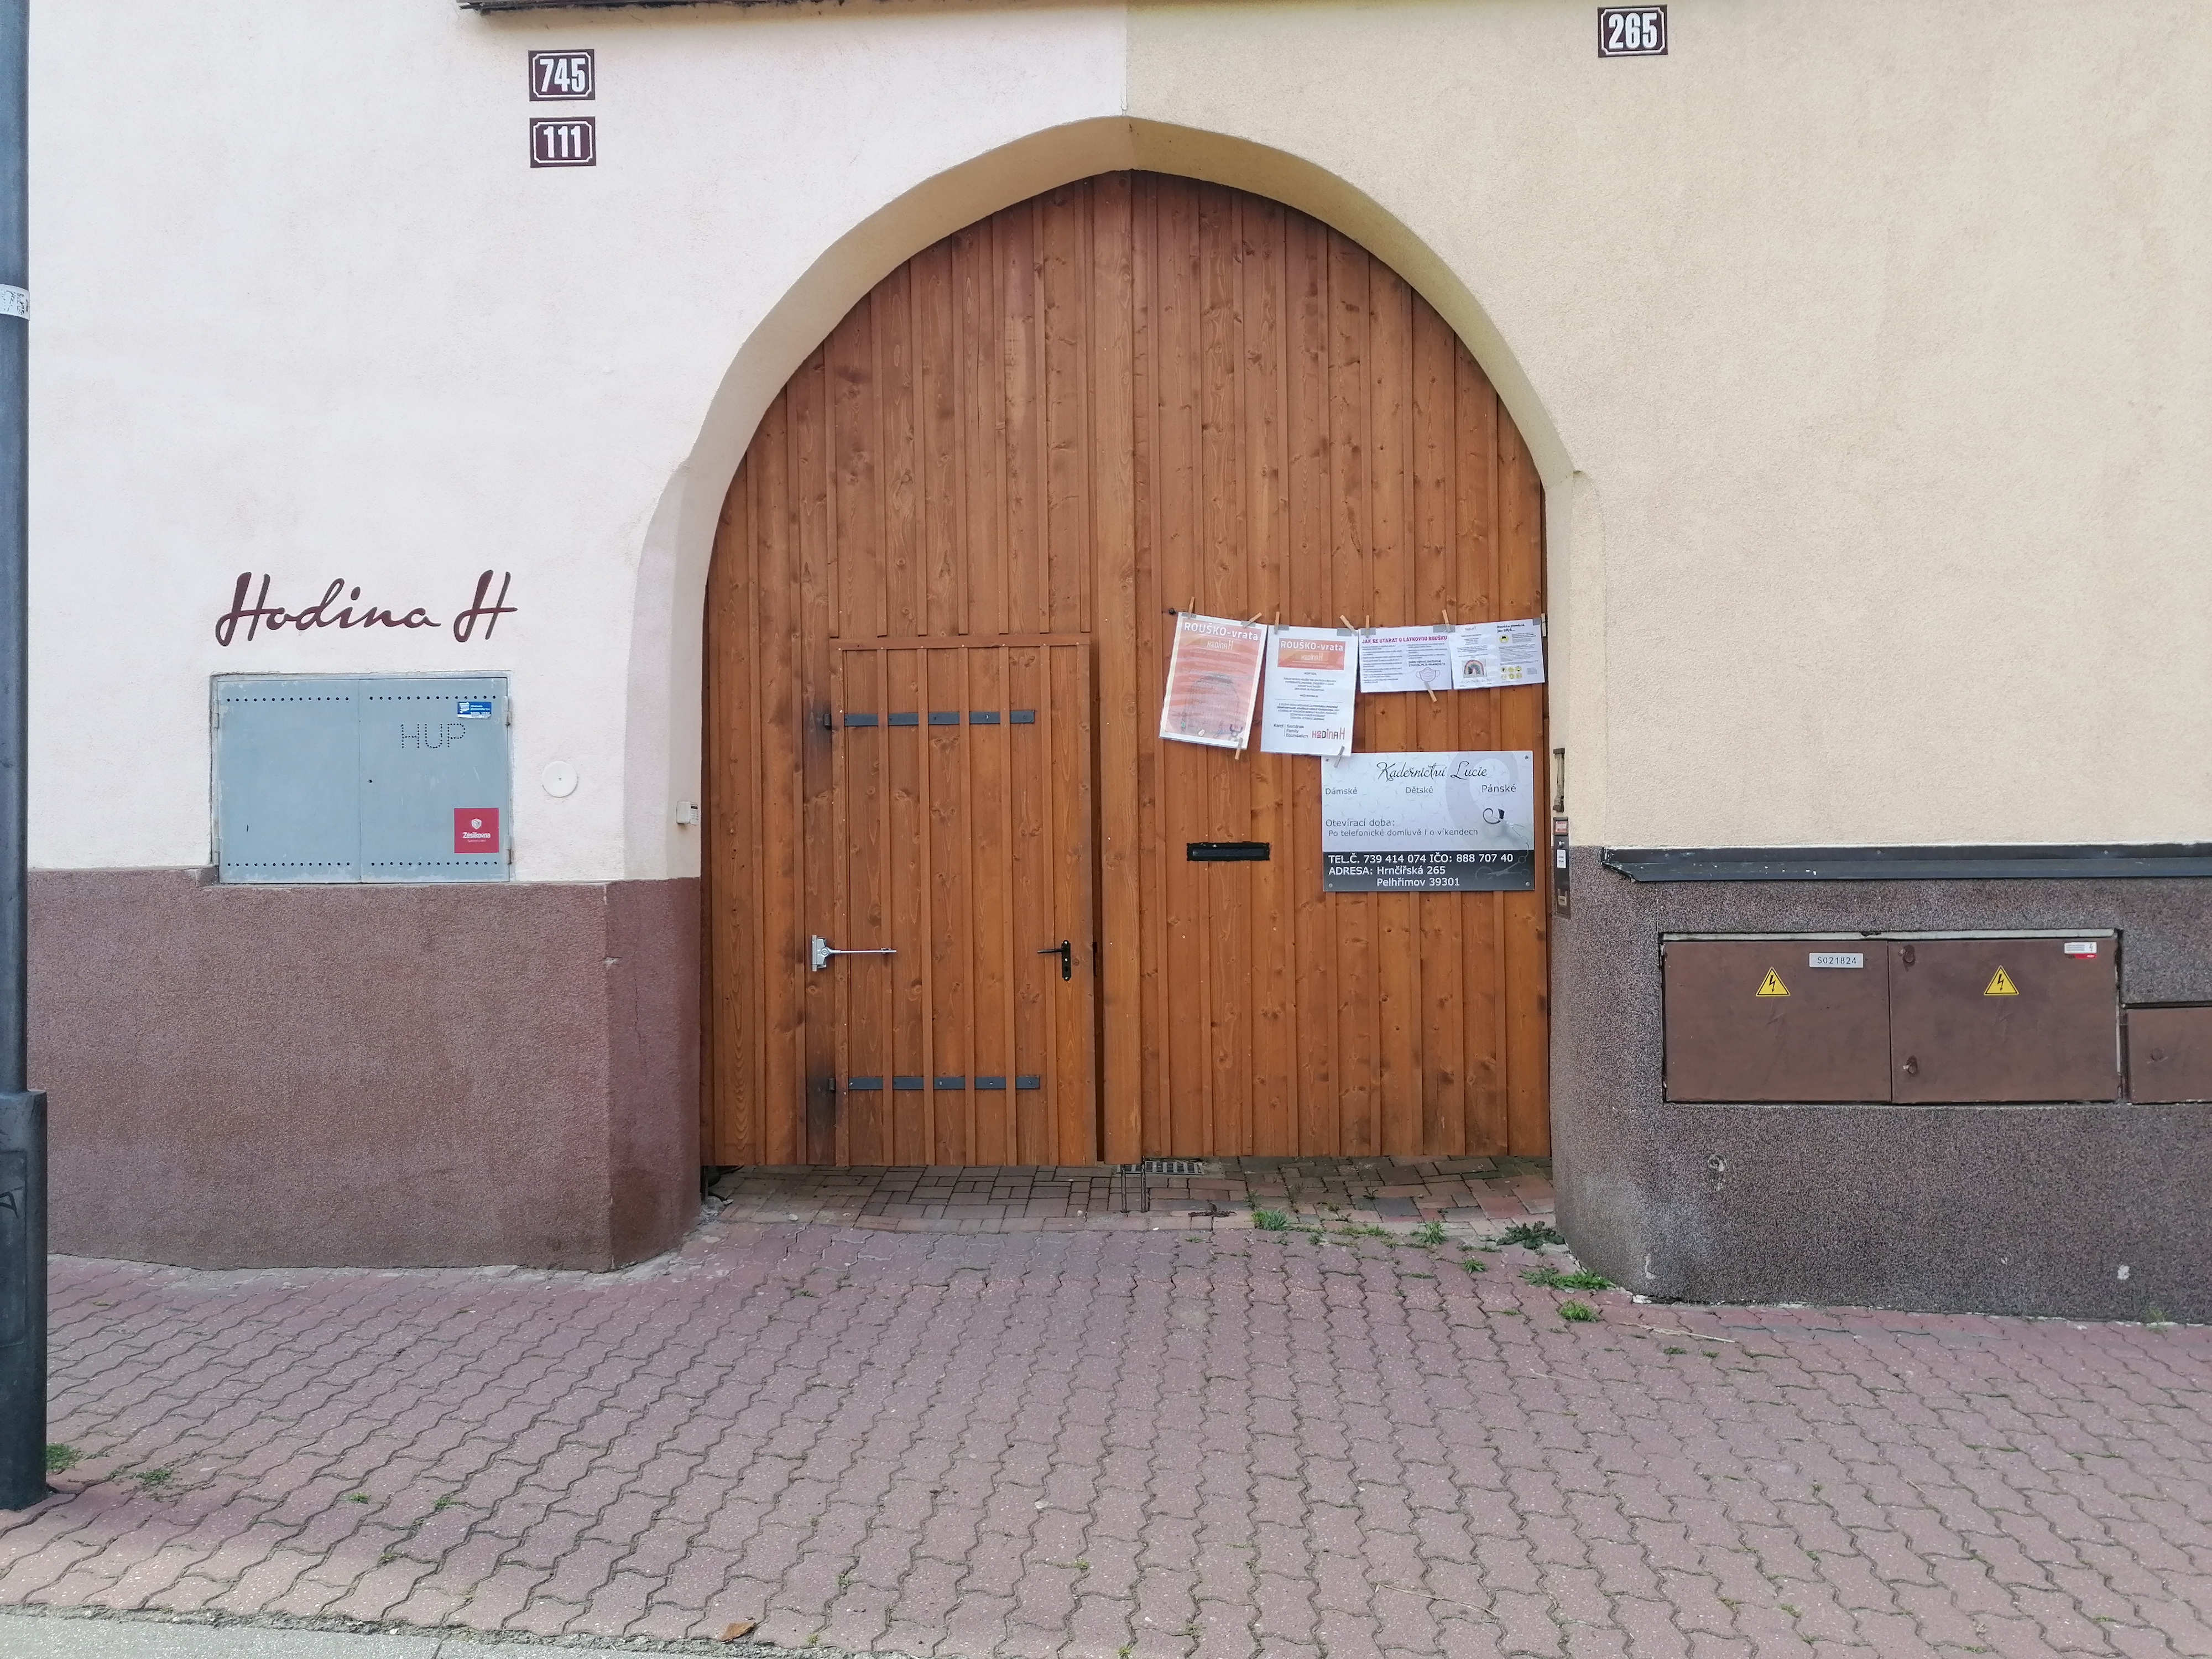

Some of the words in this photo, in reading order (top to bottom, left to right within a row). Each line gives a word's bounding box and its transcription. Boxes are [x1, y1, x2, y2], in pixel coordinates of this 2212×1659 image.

[1608, 12, 1657, 49] 265
[539, 58, 586, 92] 745
[543, 125, 581, 158] 111
[215, 571, 442, 646] Hodina
[453, 570, 518, 643] H
[1183, 622, 1259, 641] ROUŠKO-vrata
[1281, 640, 1343, 651] ROUŠKO-vrata
[400, 722, 466, 749] HUP
[1376, 761, 1447, 782] Kadeřnictví
[1450, 760, 1488, 780] Lucie
[1481, 784, 1516, 793] Pánské
[1326, 818, 1366, 827] Otevírací
[1369, 818, 1395, 827] doba:
[1328, 852, 1360, 863] TEL.Č.
[1364, 854, 1382, 863] 739
[1385, 854, 1404, 863] 414
[1407, 854, 1426, 863] 074
[1430, 852, 1452, 863] IČO:
[1456, 853, 1475, 863] 888
[1479, 853, 1498, 862] 707
[1500, 853, 1513, 862] 40
[1328, 866, 1373, 875] ADRESA:
[1377, 865, 1423, 875] Hrnčířská
[1427, 865, 1446, 874] 265
[1377, 877, 1426, 886] Pelhřimov
[1429, 877, 1460, 886] 39301
[1817, 956, 1857, 964] S021824
